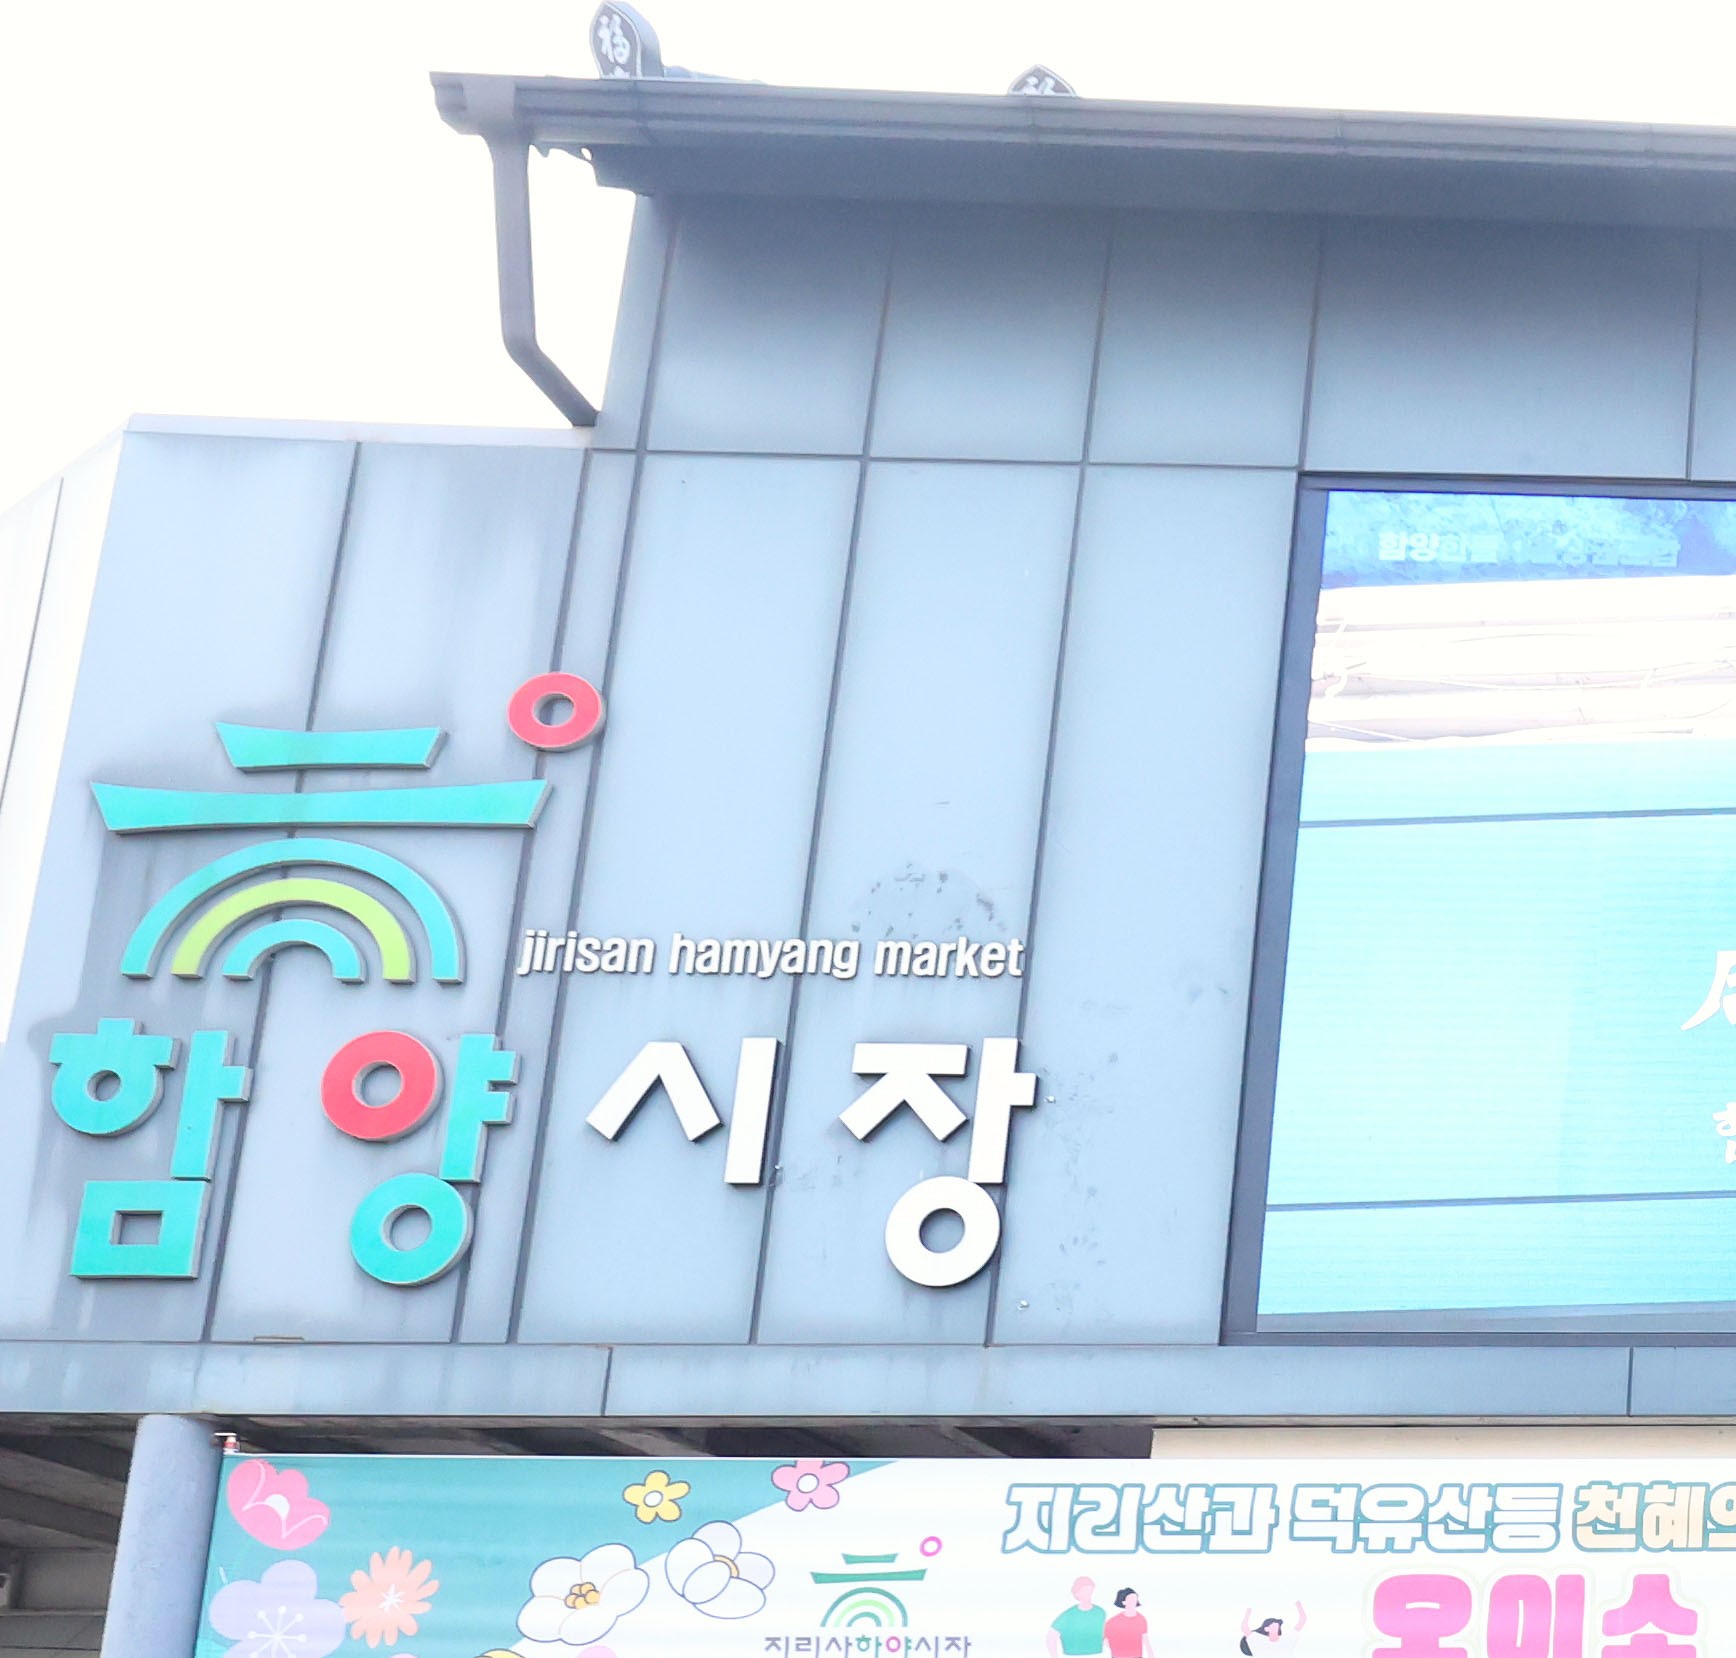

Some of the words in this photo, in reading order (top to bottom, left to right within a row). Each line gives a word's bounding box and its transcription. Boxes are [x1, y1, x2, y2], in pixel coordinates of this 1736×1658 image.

[517, 929, 653, 979] jirisan
[668, 932, 859, 980] hamyang
[874, 937, 1024, 978] market
[50, 1018, 518, 1285] 함양
[586, 1036, 1037, 1287] 시장
[1001, 1482, 1279, 1556] 지리산과
[1287, 1481, 1565, 1555] 덕유산등
